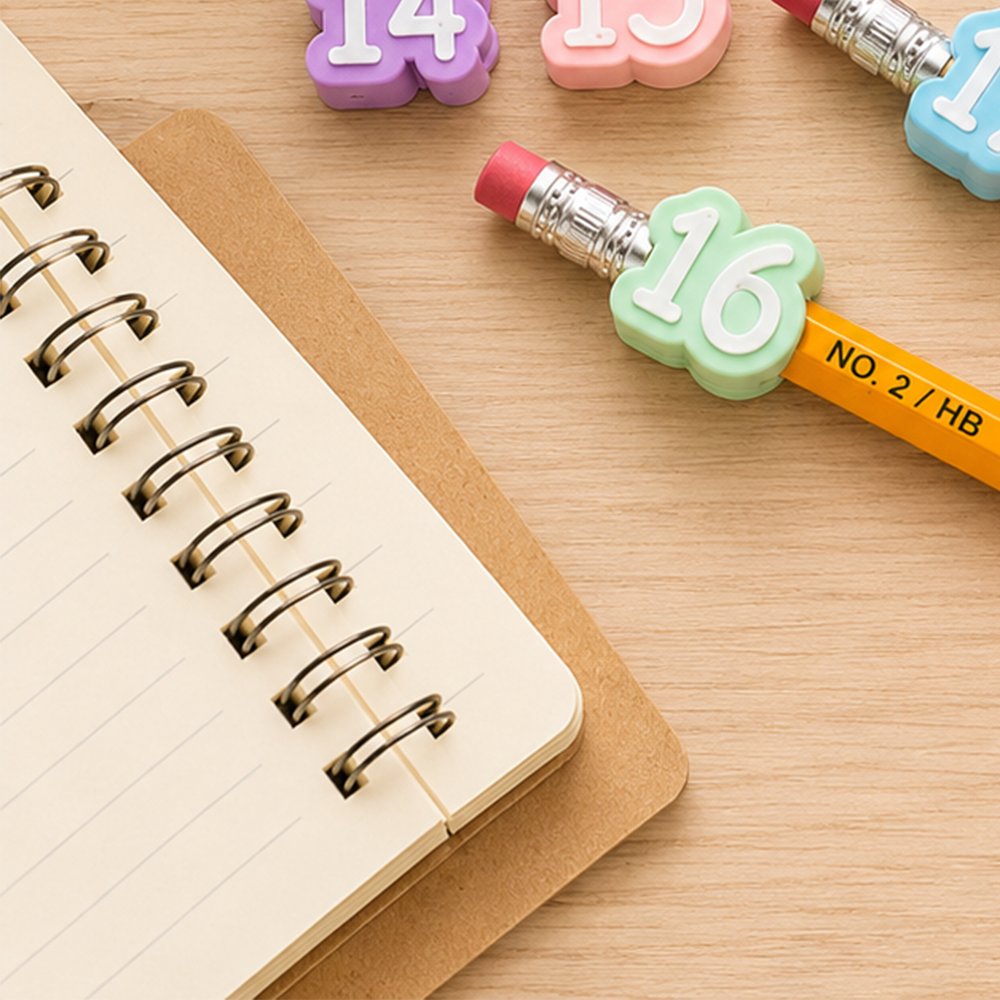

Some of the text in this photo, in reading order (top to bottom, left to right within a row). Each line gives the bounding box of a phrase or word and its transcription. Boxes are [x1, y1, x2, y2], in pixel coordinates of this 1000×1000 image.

[632, 206, 796, 356] 16
[826, 340, 983, 437] NO. 2 / HB
